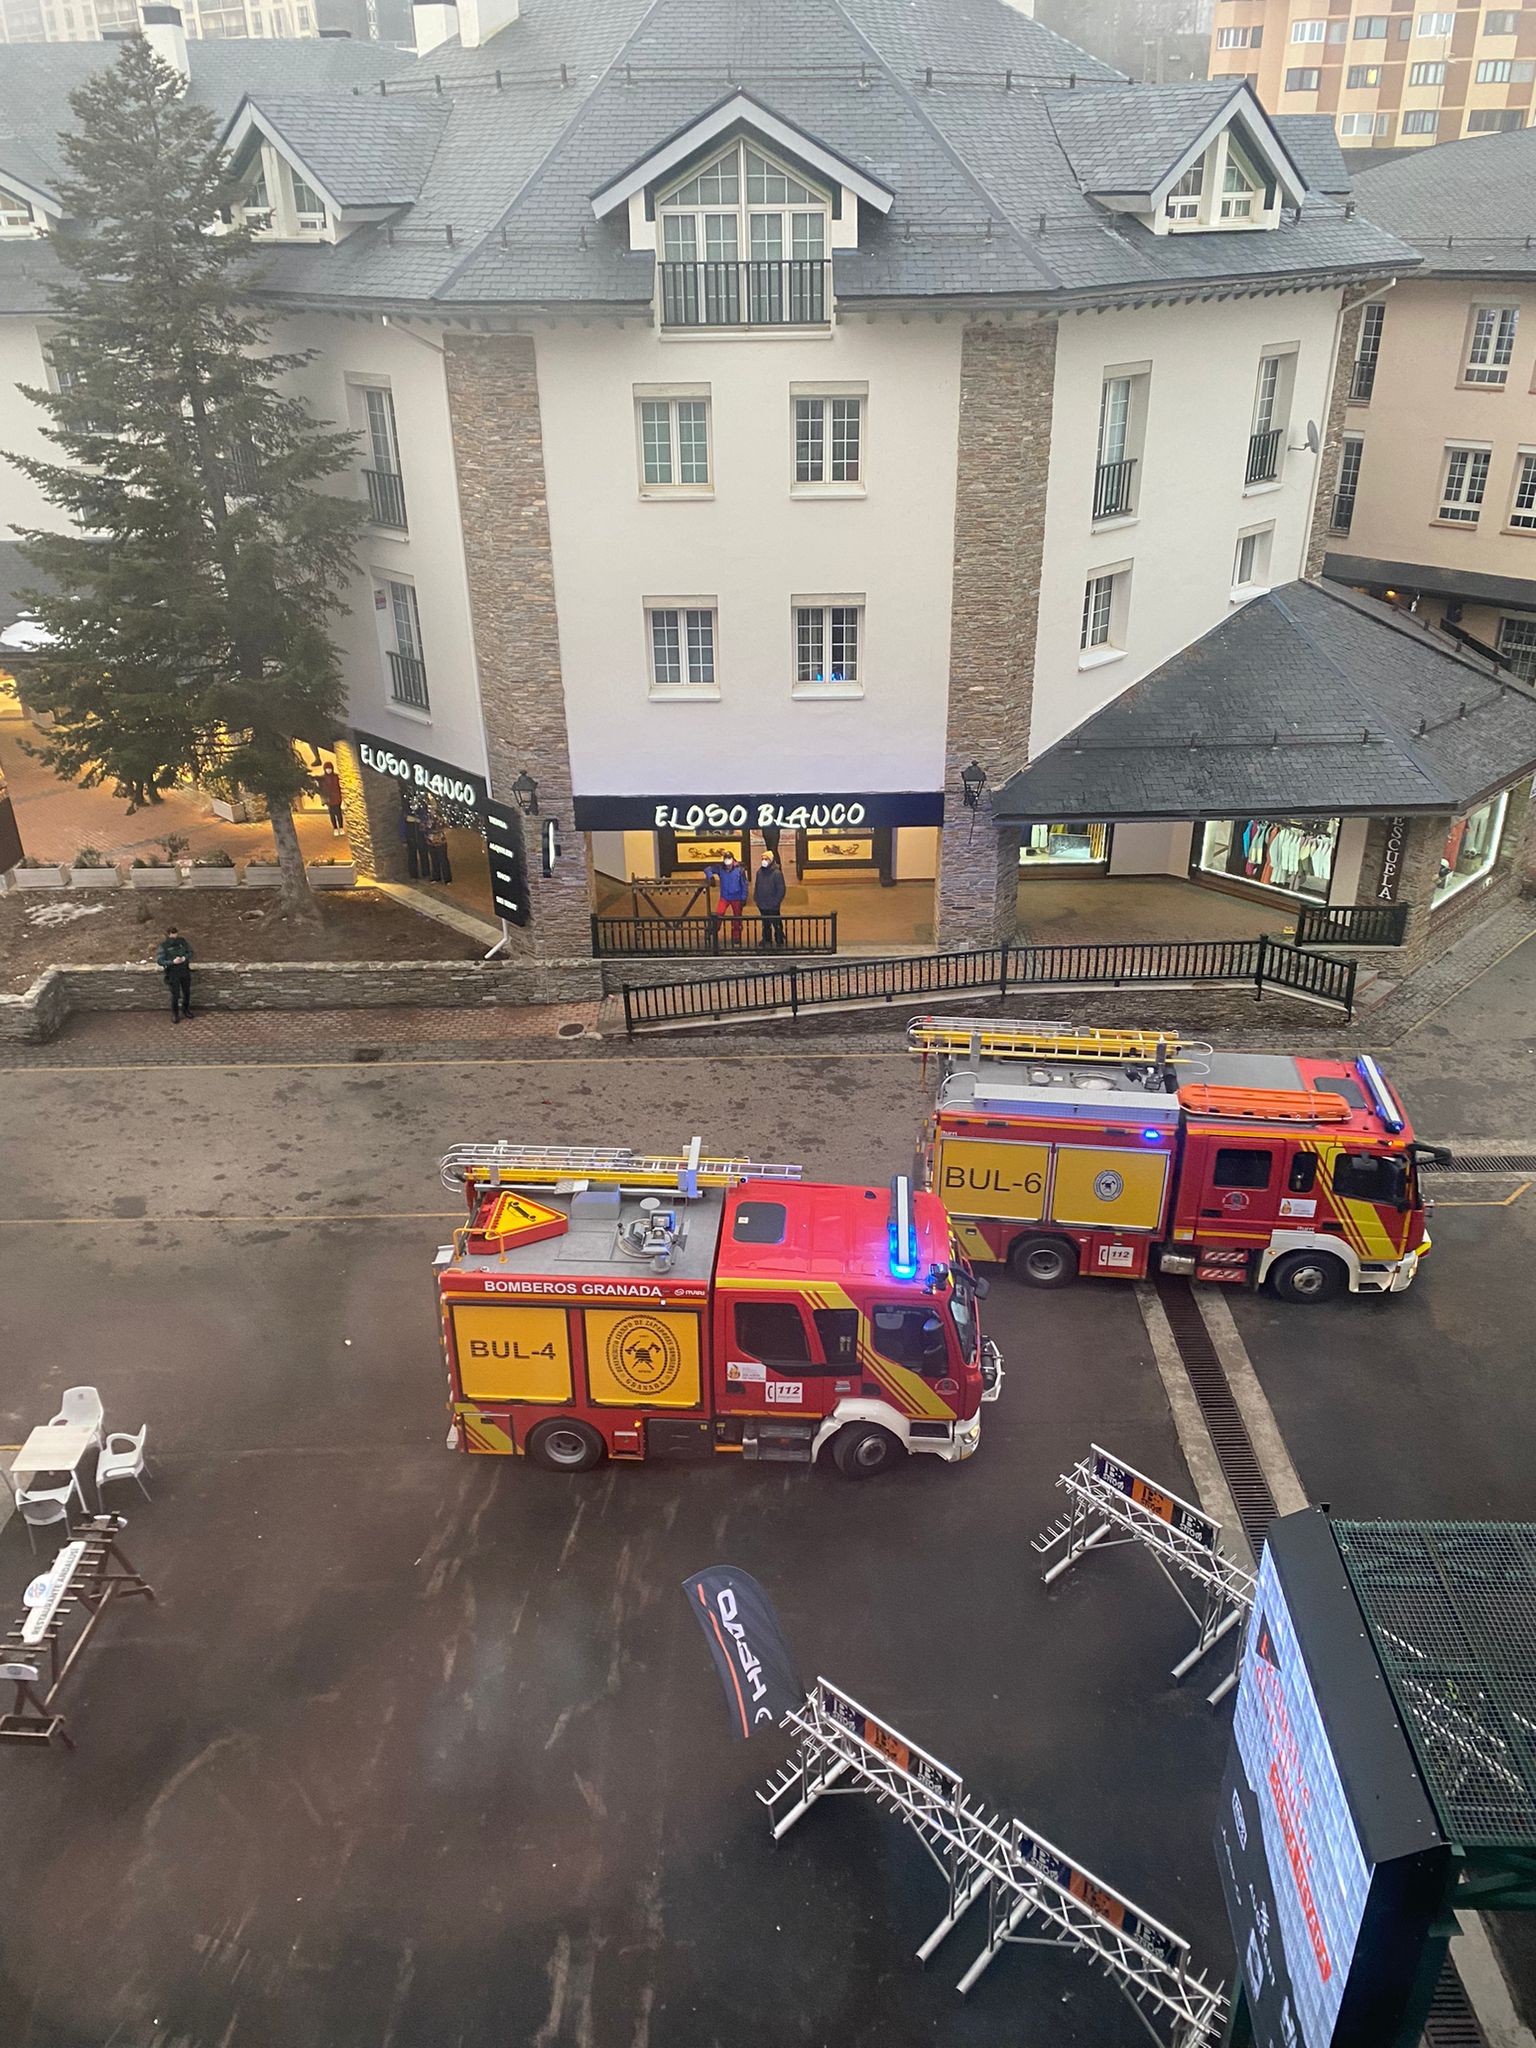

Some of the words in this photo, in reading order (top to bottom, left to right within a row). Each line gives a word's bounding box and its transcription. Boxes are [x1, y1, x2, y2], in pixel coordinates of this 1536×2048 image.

[413, 764, 475, 806] BLANCO
[757, 803, 865, 828] BLANCO
[1378, 817, 1405, 900] ESCUELA
[945, 1166, 1042, 1194] BUL-6
[484, 1280, 577, 1294] BOMBEROS
[582, 1283, 662, 1297] GRANADA
[470, 1340, 556, 1360] BUL-4
[778, 1385, 800, 1394] 112
